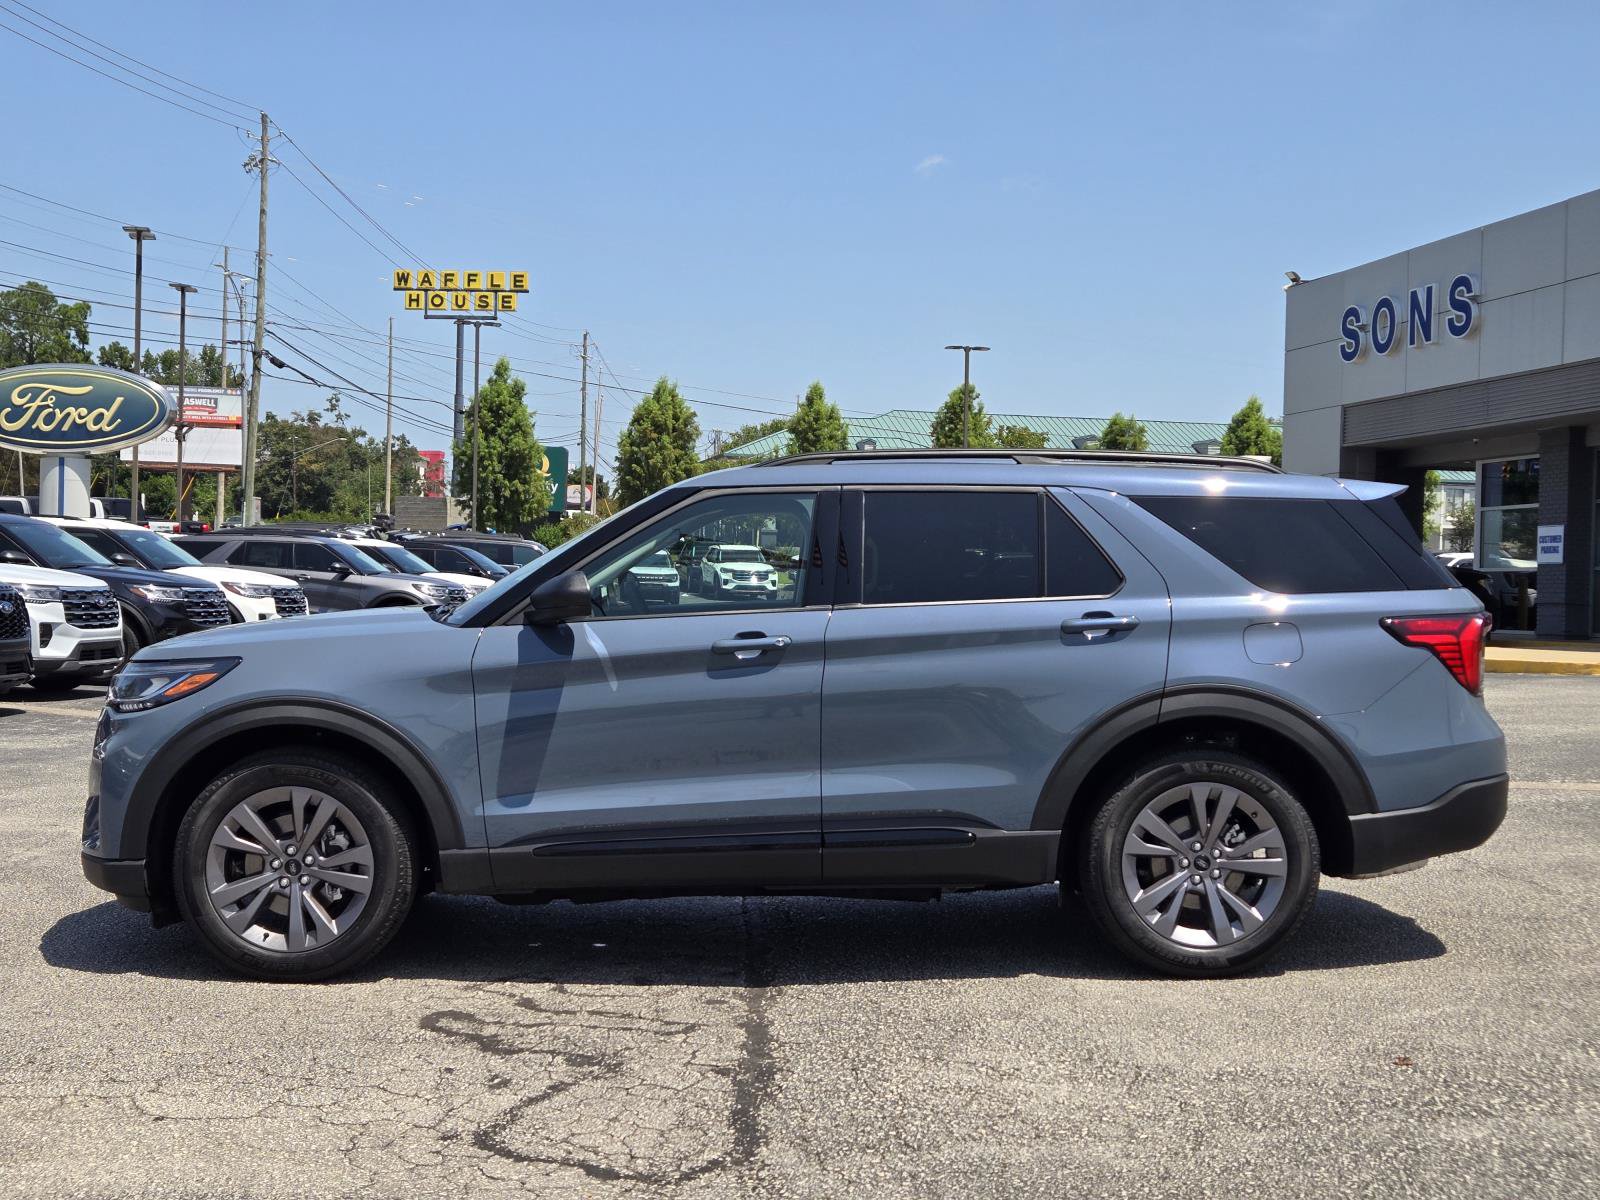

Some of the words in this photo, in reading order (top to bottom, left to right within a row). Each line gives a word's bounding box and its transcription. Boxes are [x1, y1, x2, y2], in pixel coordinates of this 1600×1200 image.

[395, 271, 527, 289] WAFFLE
[407, 292, 515, 310] HOUSE
[1338, 274, 1478, 363] SONS
[0, 383, 124, 432] Ford
[183, 397, 217, 407] ASWELL
[1211, 763, 1271, 791] MICHELIN
